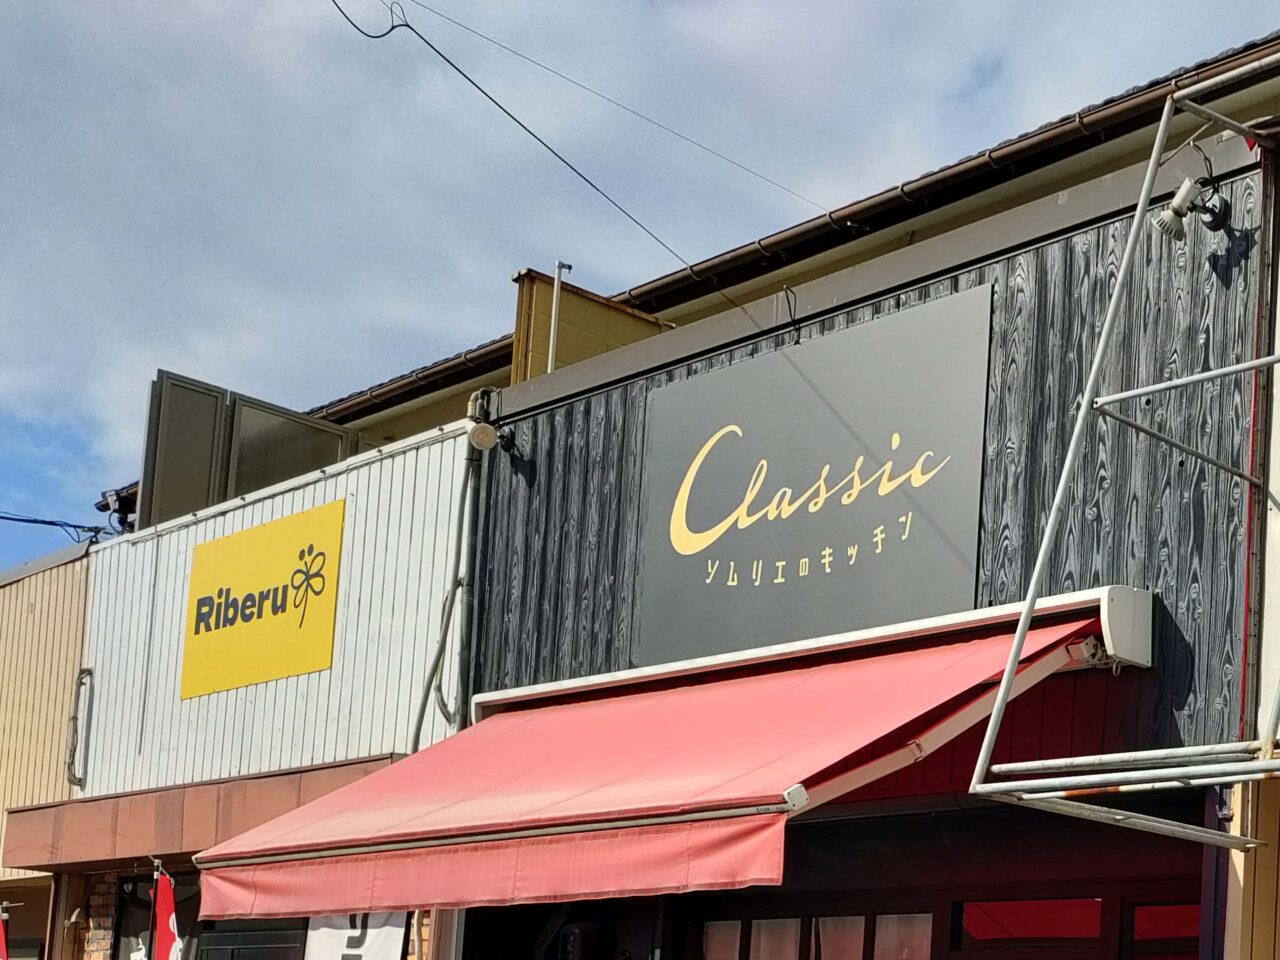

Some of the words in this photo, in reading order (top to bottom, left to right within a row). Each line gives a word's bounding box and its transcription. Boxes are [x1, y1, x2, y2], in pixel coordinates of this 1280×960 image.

[669, 424, 951, 556] Classic
[705, 511, 913, 587] ソムリエのキッチン
[193, 584, 289, 636] Riberu
